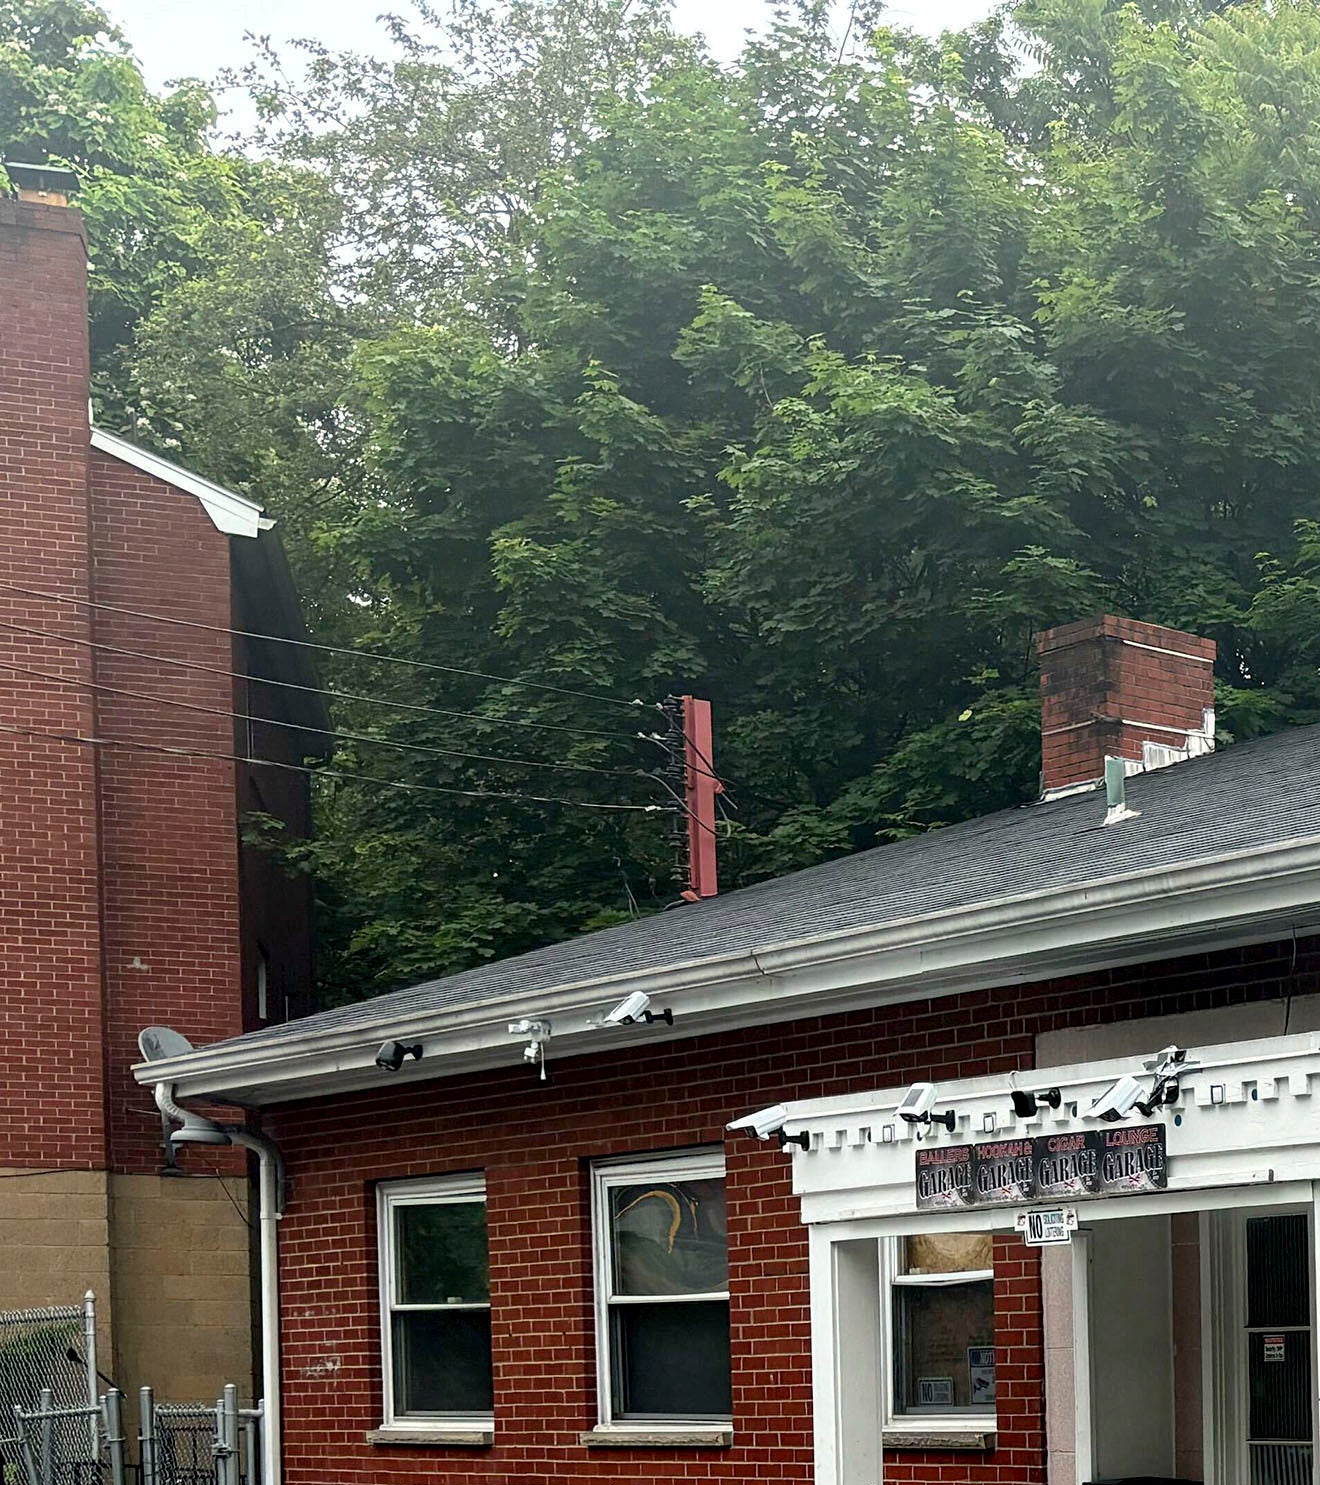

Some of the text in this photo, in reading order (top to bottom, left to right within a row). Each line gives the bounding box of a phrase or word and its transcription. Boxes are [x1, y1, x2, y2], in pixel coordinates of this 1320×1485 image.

[920, 1148, 970, 1165] BALLERS
[977, 1143, 1023, 1159] HOOKAH
[1048, 1135, 1086, 1152] CIGAR
[1105, 1127, 1159, 1147] LOUNGE
[1102, 1143, 1163, 1183] GARAGE
[919, 1163, 971, 1199] GARAGE
[977, 1157, 1033, 1194] GARAGE
[1038, 1149, 1096, 1188] GARAGE
[1028, 1214, 1043, 1239] NO
[921, 1383, 933, 1402] NO
